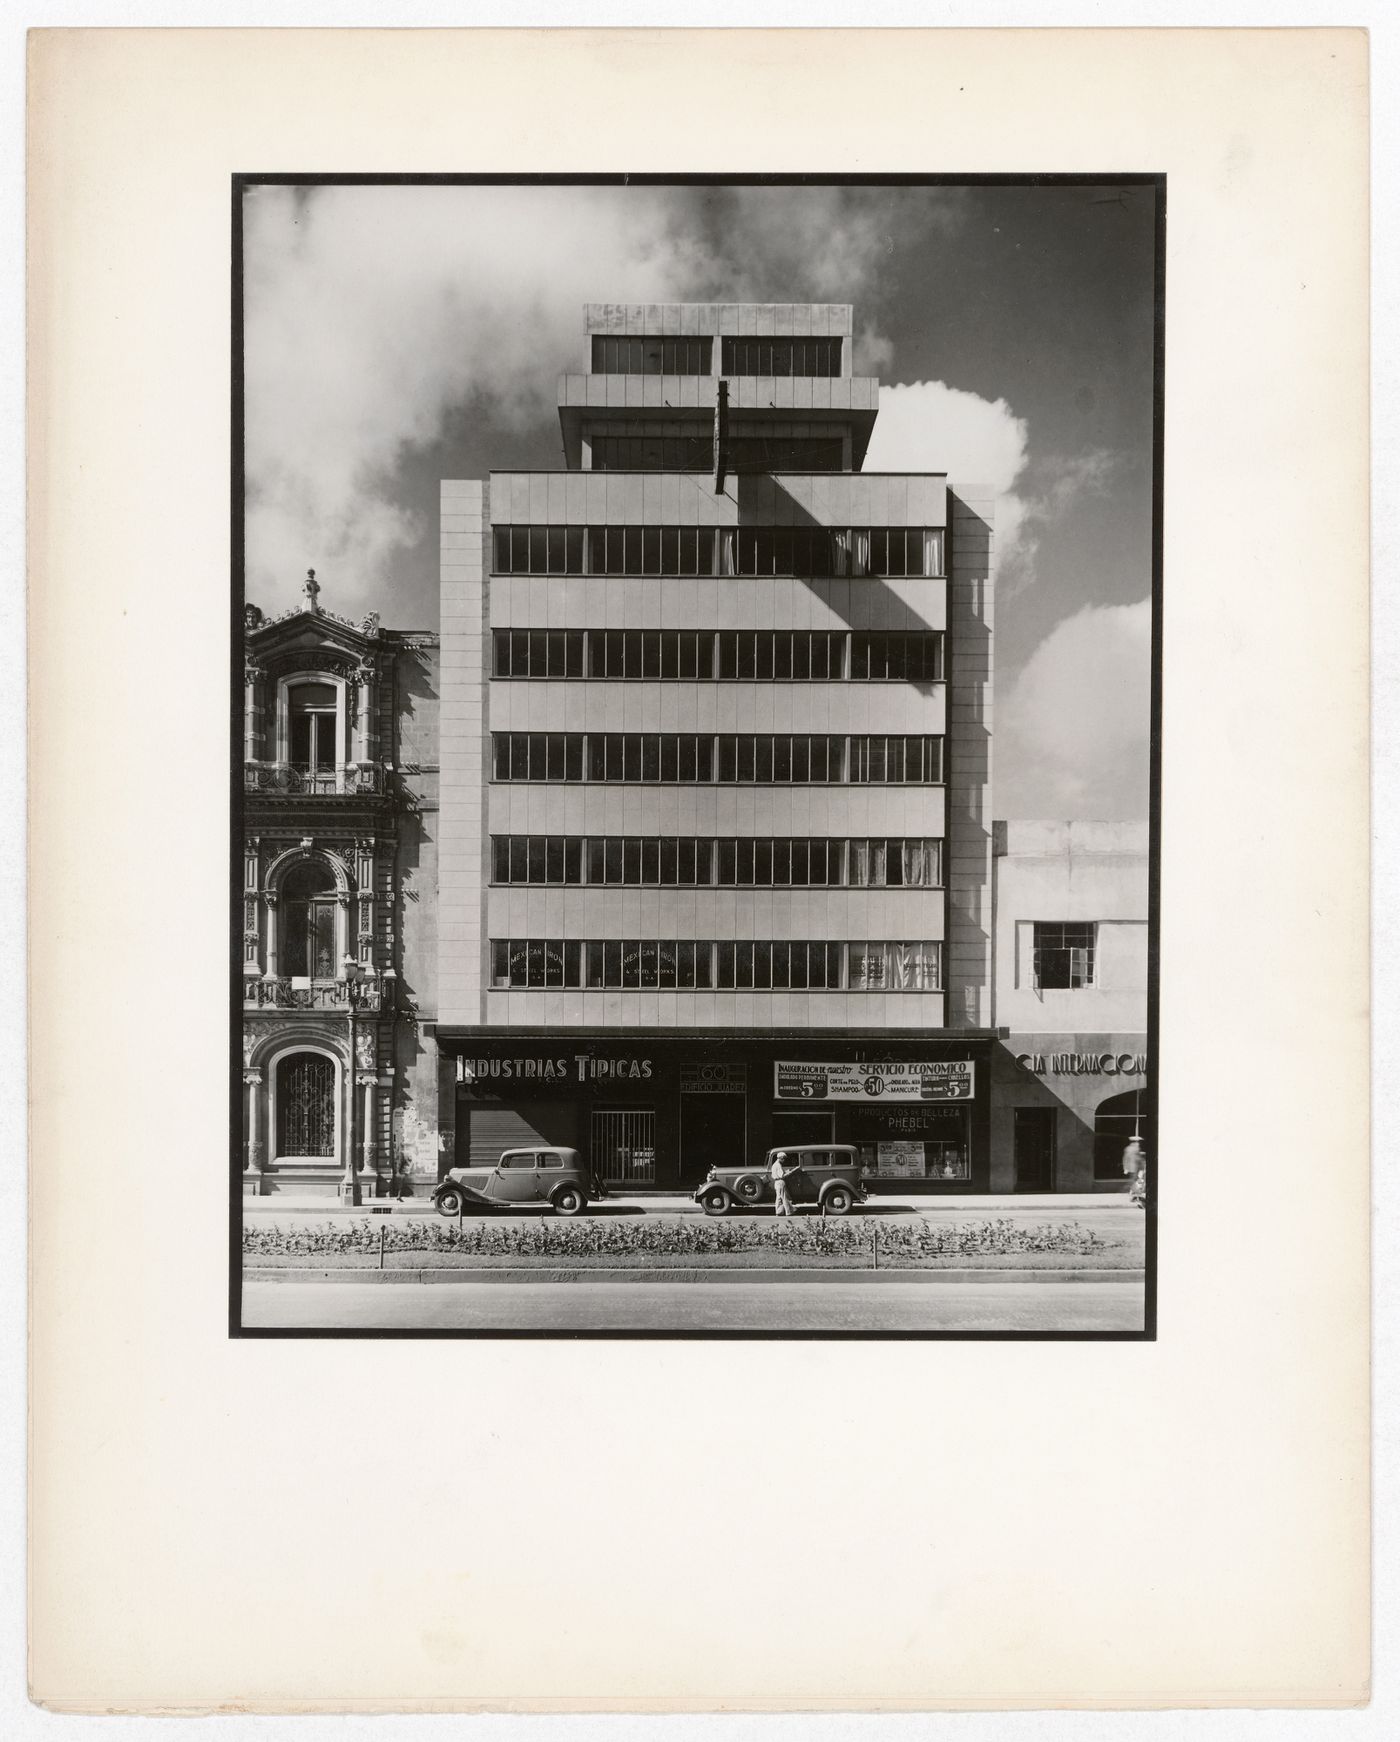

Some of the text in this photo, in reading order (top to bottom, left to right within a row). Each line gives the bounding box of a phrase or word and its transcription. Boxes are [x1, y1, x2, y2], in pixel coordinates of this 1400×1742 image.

[547, 949, 563, 966] IRON
[457, 1055, 653, 1082] INDUSTRIAS TIPICAS
[701, 1064, 726, 1080] 60
[858, 1064, 905, 1075] SERVICIO
[908, 1062, 967, 1075] ECONOMICO
[1015, 1053, 1047, 1076] CIA
[921, 1108, 961, 1117] BELLEZA
